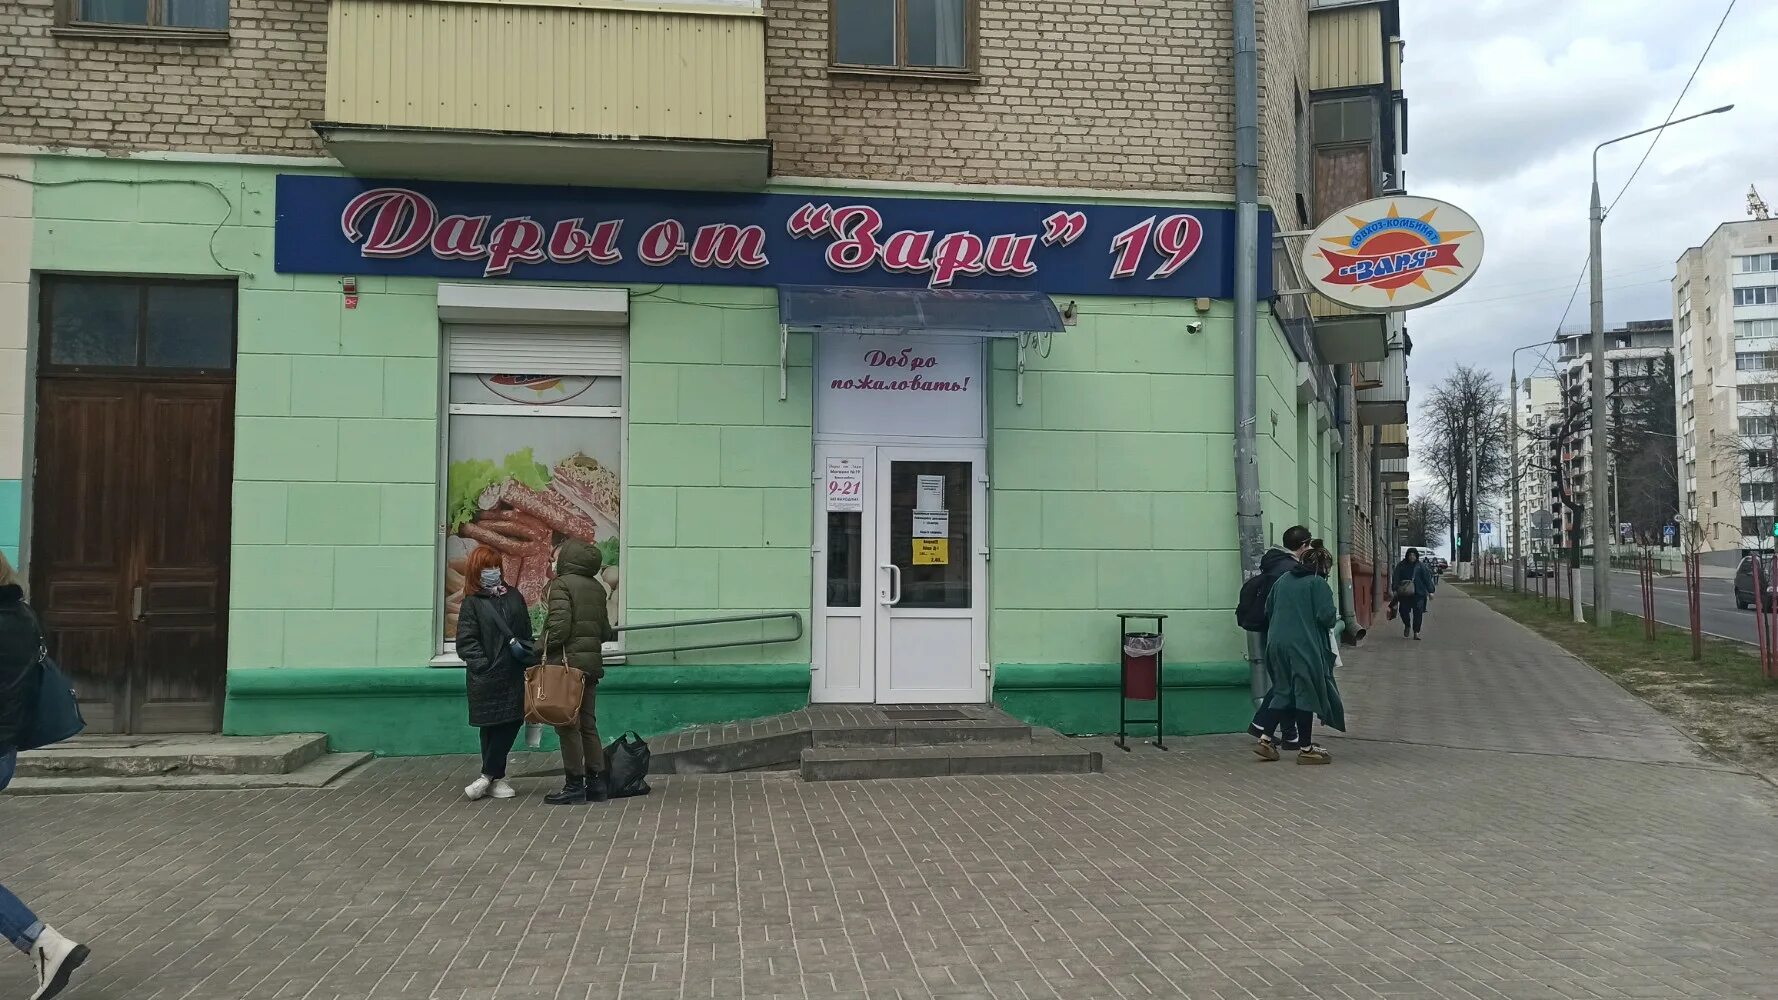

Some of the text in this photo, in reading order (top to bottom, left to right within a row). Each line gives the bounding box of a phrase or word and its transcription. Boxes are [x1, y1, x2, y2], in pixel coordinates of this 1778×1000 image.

[340, 187, 624, 278] Дары
[637, 218, 770, 270] от
[1108, 213, 1204, 281] 19
[1351, 218, 1439, 247] СОВХОЗ-КОМБИНАТ
[863, 347, 938, 371] Добро
[830, 374, 971, 392] пожаловать!
[829, 480, 861, 496] 9-21
